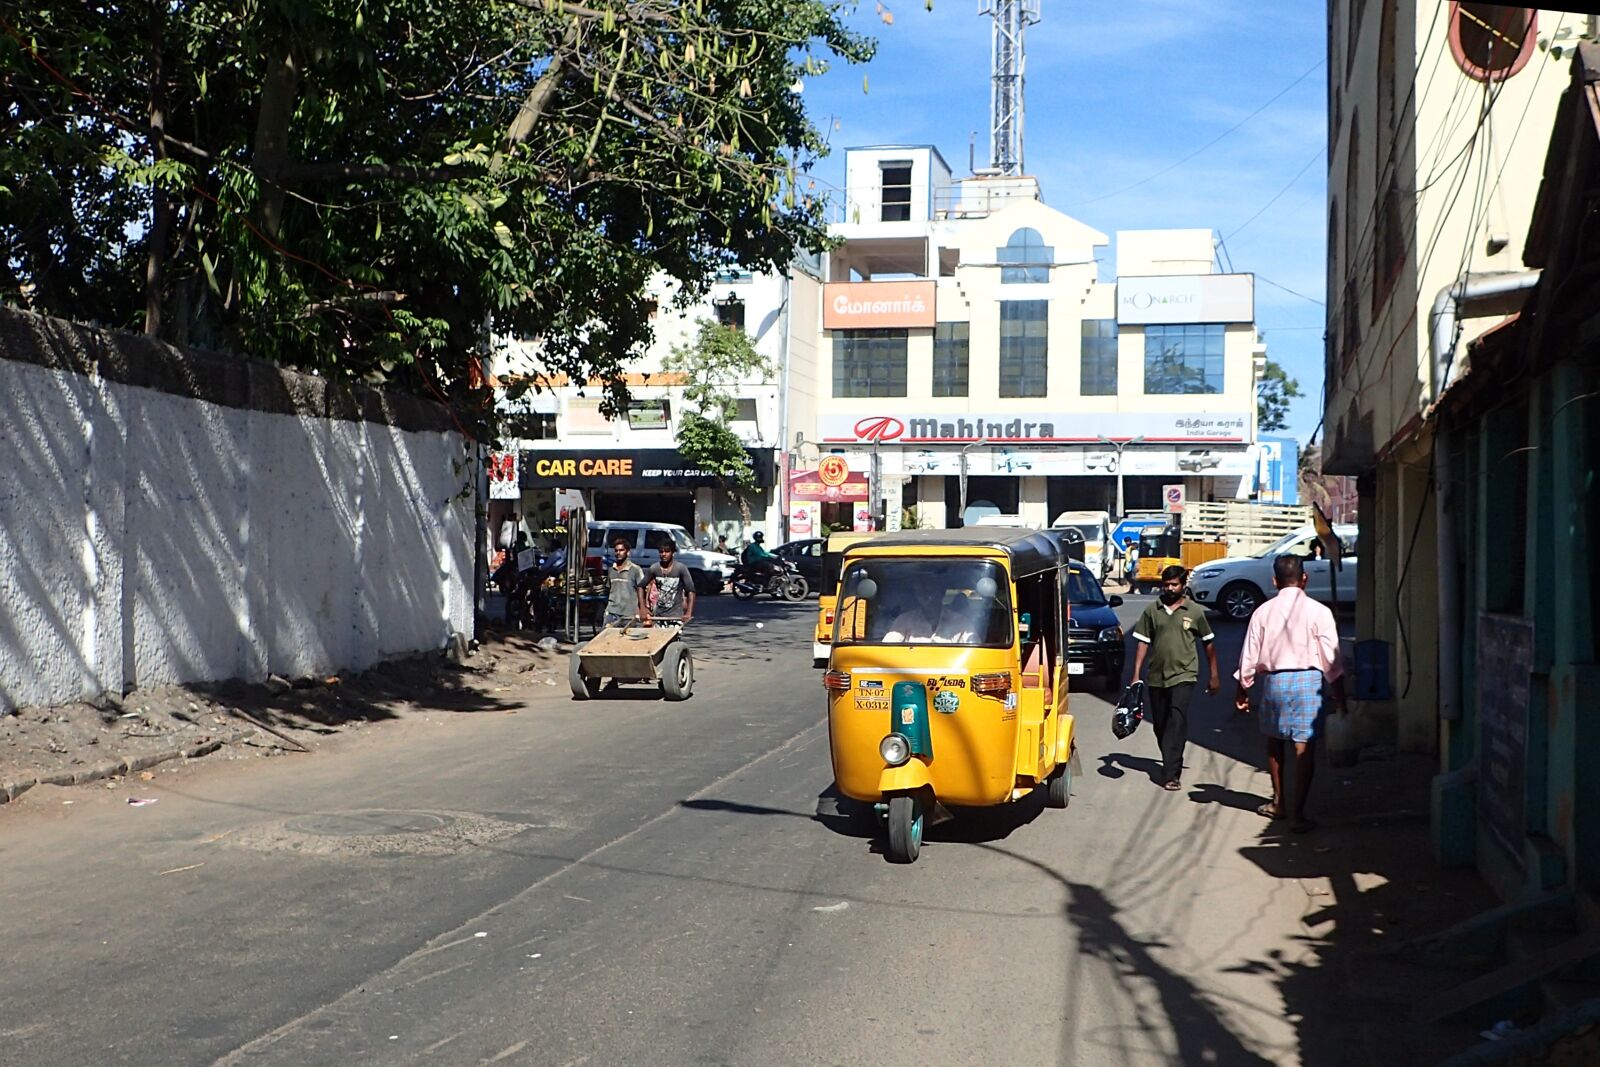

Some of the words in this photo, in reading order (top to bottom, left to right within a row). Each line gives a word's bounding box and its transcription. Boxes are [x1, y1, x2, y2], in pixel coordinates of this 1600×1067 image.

[909, 418, 1055, 439] Mahindra
[1206, 429, 1232, 438] Garage
[536, 459, 577, 476] CAR
[579, 458, 633, 476] CARE
[641, 469, 661, 477] KEEP
[662, 469, 683, 477] YOUR
[684, 469, 700, 477] CAR
